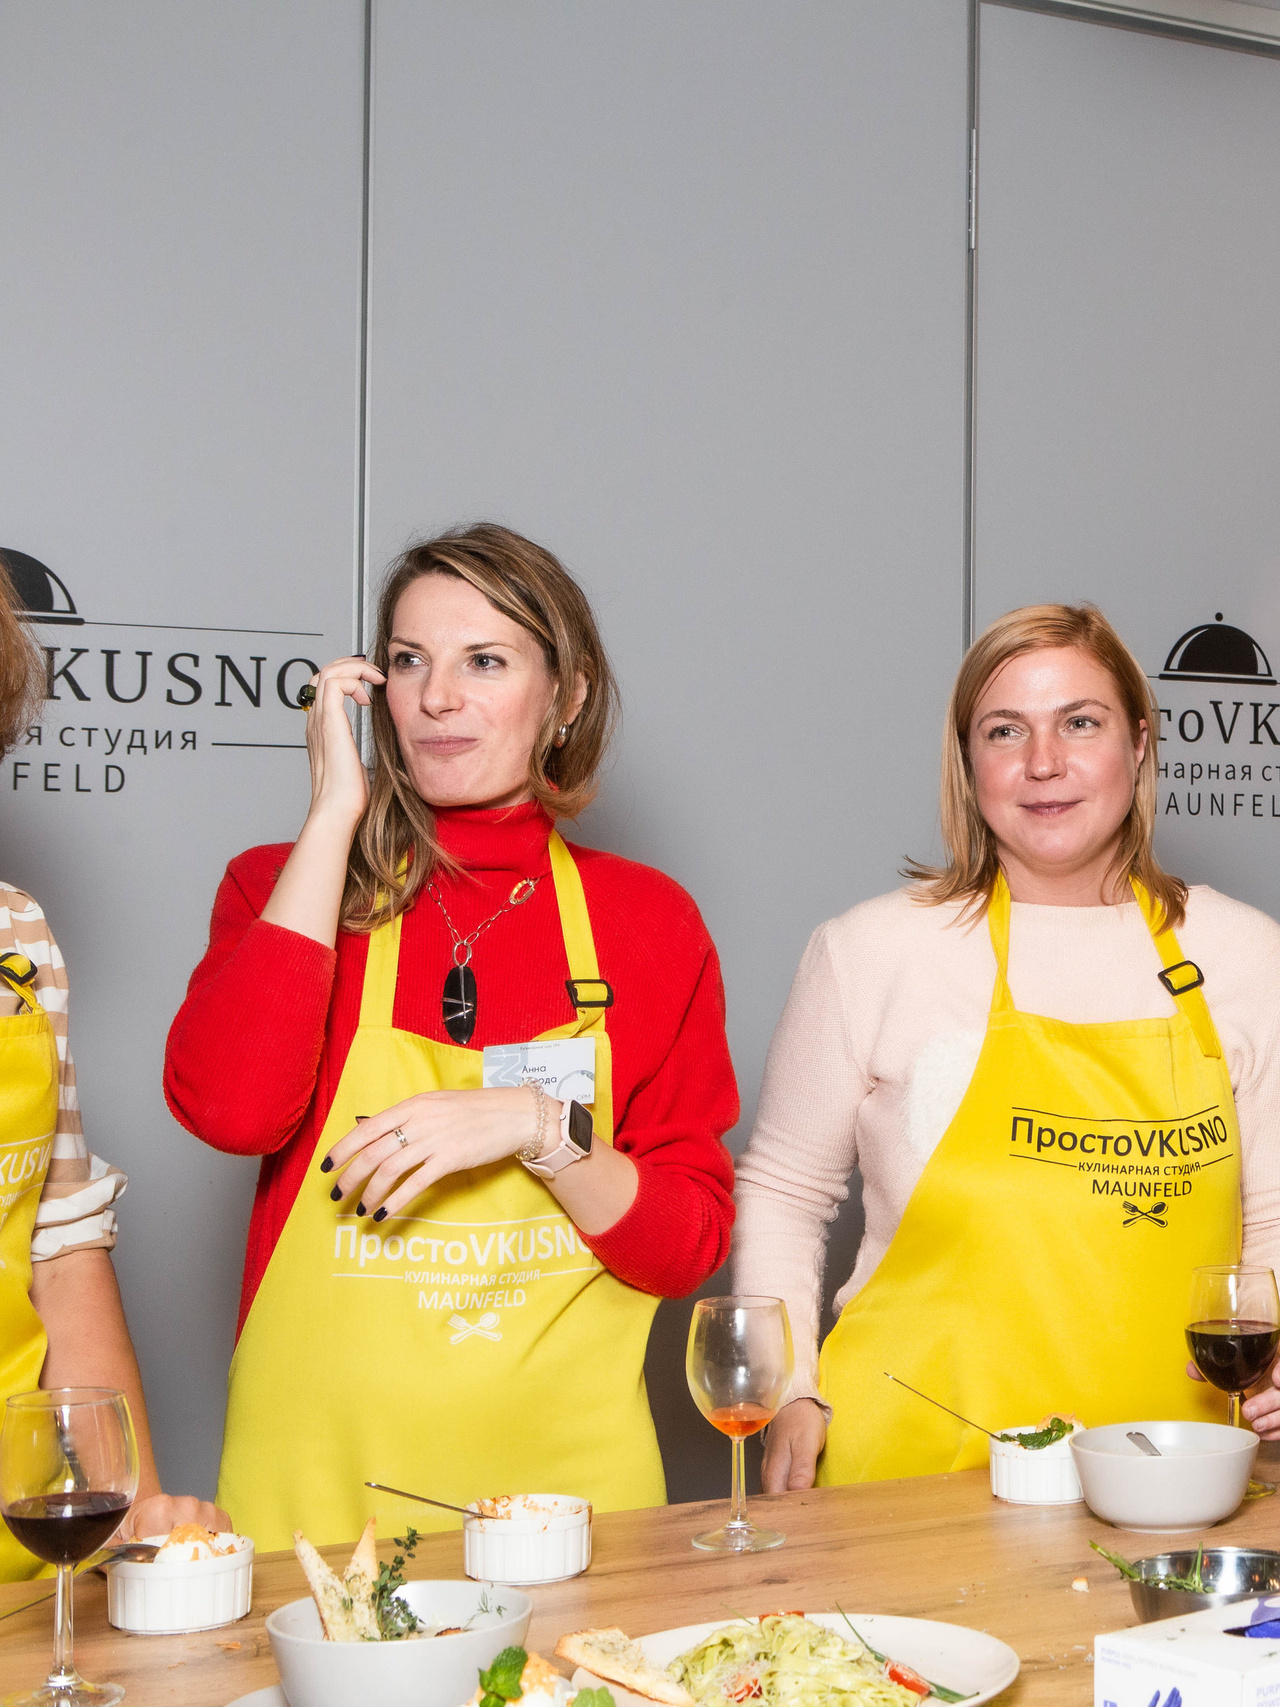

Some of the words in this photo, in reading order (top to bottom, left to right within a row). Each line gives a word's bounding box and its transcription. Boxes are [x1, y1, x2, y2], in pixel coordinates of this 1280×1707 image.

[58, 726, 198, 756] студия
[521, 1065, 547, 1074] Анна
[1078, 1161, 1160, 1176] КУЛИНАРНАЯ
[1163, 1161, 1202, 1176] СТУДИЯ
[1091, 1178, 1193, 1198] MAUNFELD
[404, 1270, 497, 1286] КУЛИНАРНАЯ
[498, 1269, 541, 1286] СТУДИЯ
[417, 1288, 526, 1311] MAUNFELD
